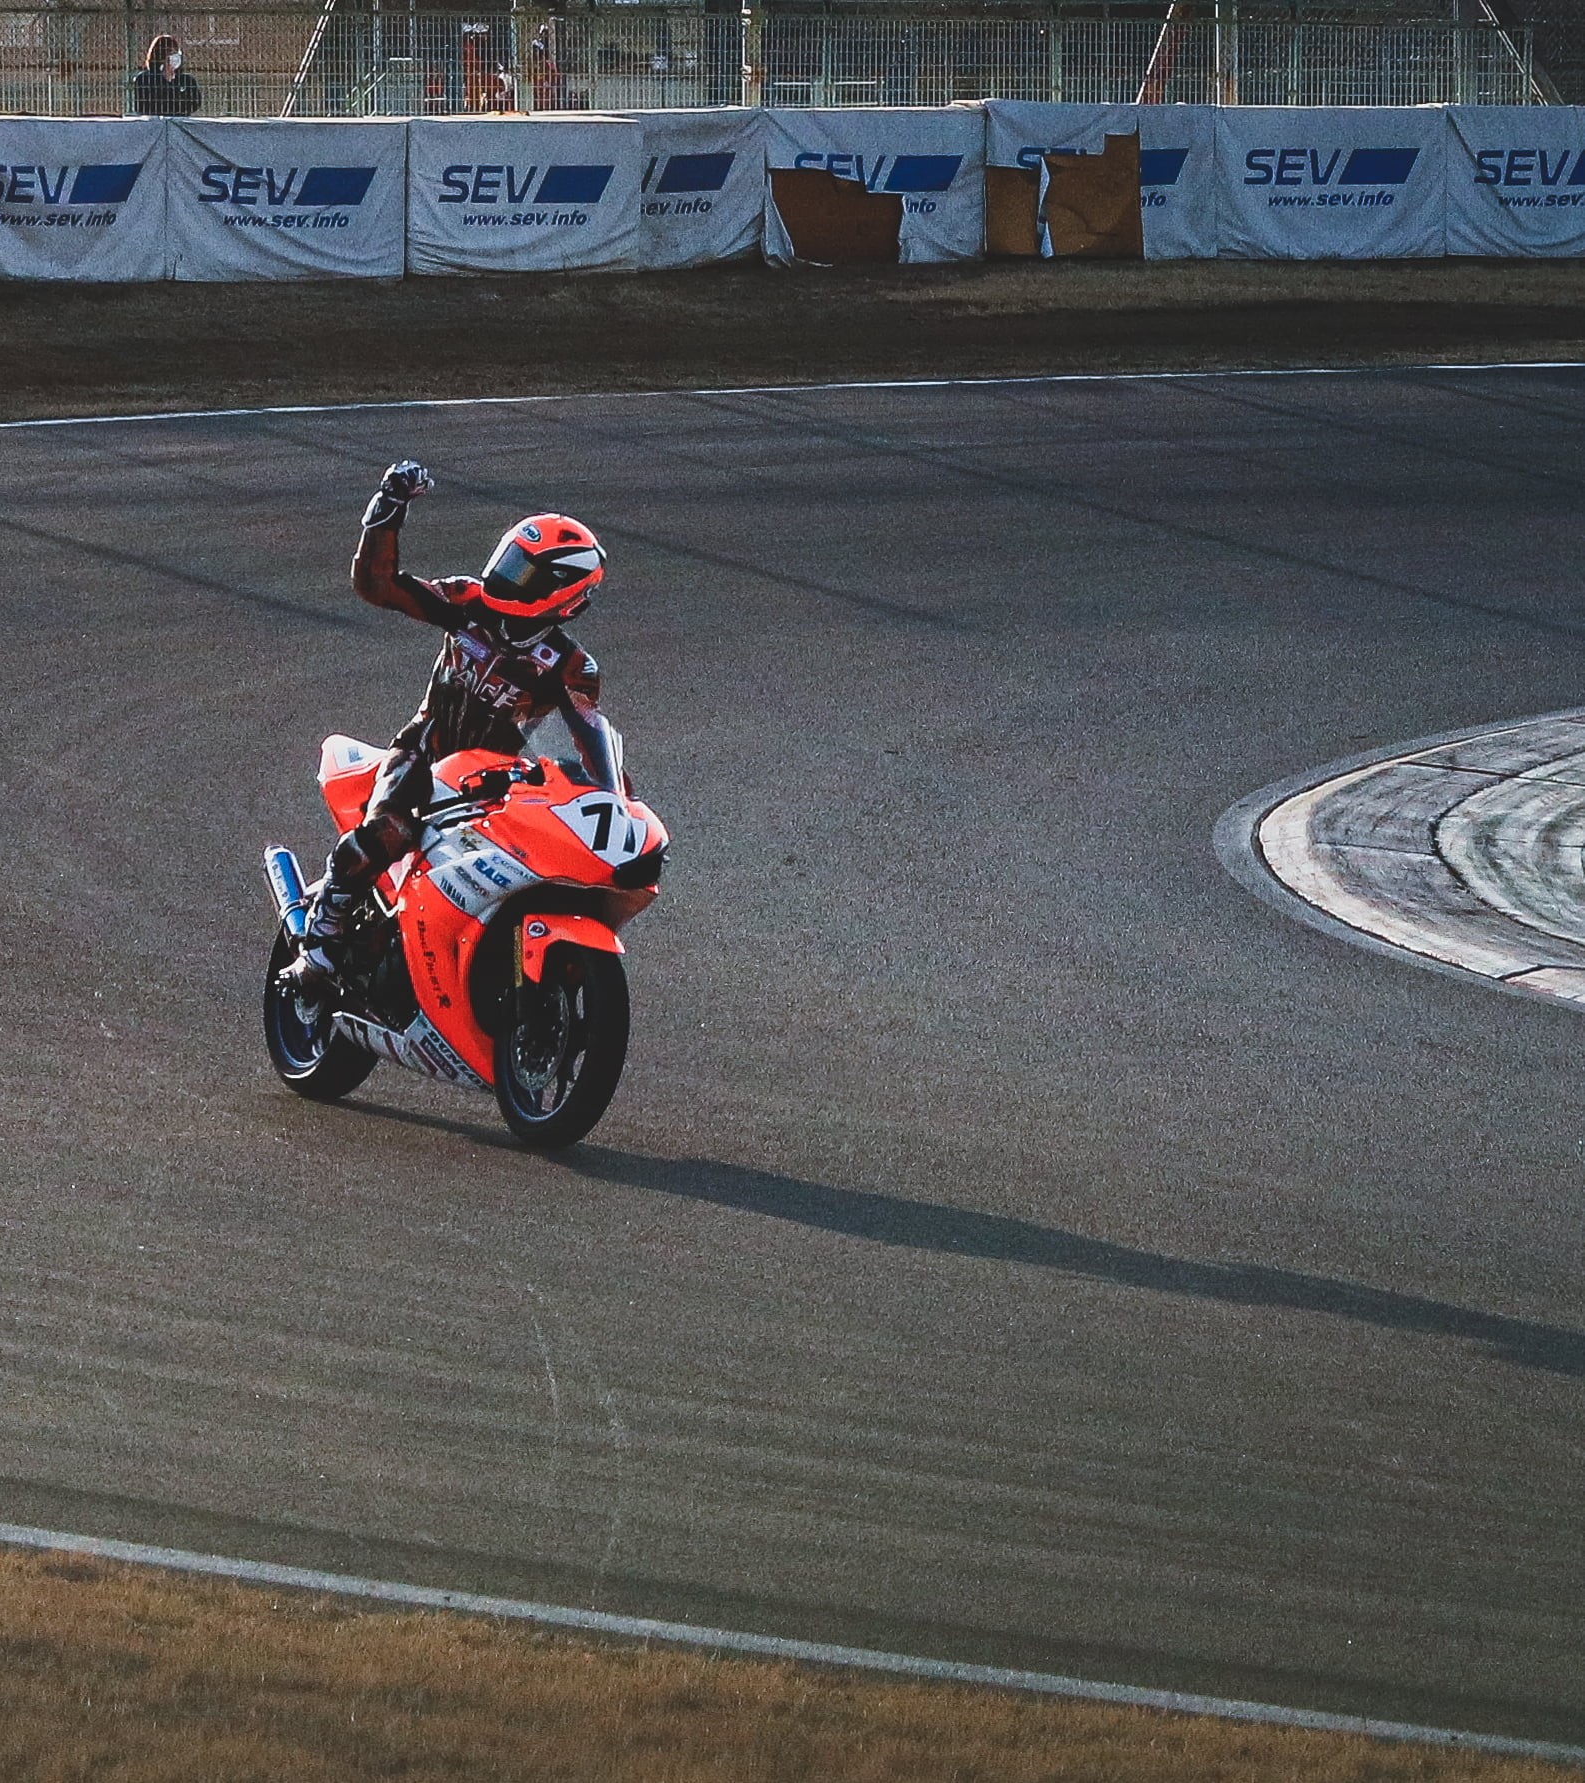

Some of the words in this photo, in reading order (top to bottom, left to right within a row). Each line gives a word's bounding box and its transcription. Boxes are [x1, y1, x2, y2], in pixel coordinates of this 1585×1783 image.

[438, 165, 538, 204] SEV
[1244, 148, 1341, 185] SEV
[1474, 150, 1570, 186] SEV
[198, 165, 298, 206] SEV
[1268, 190, 1395, 207] www.sev.info
[223, 211, 350, 228] www.sev.info
[462, 209, 588, 226] www.sev.info
